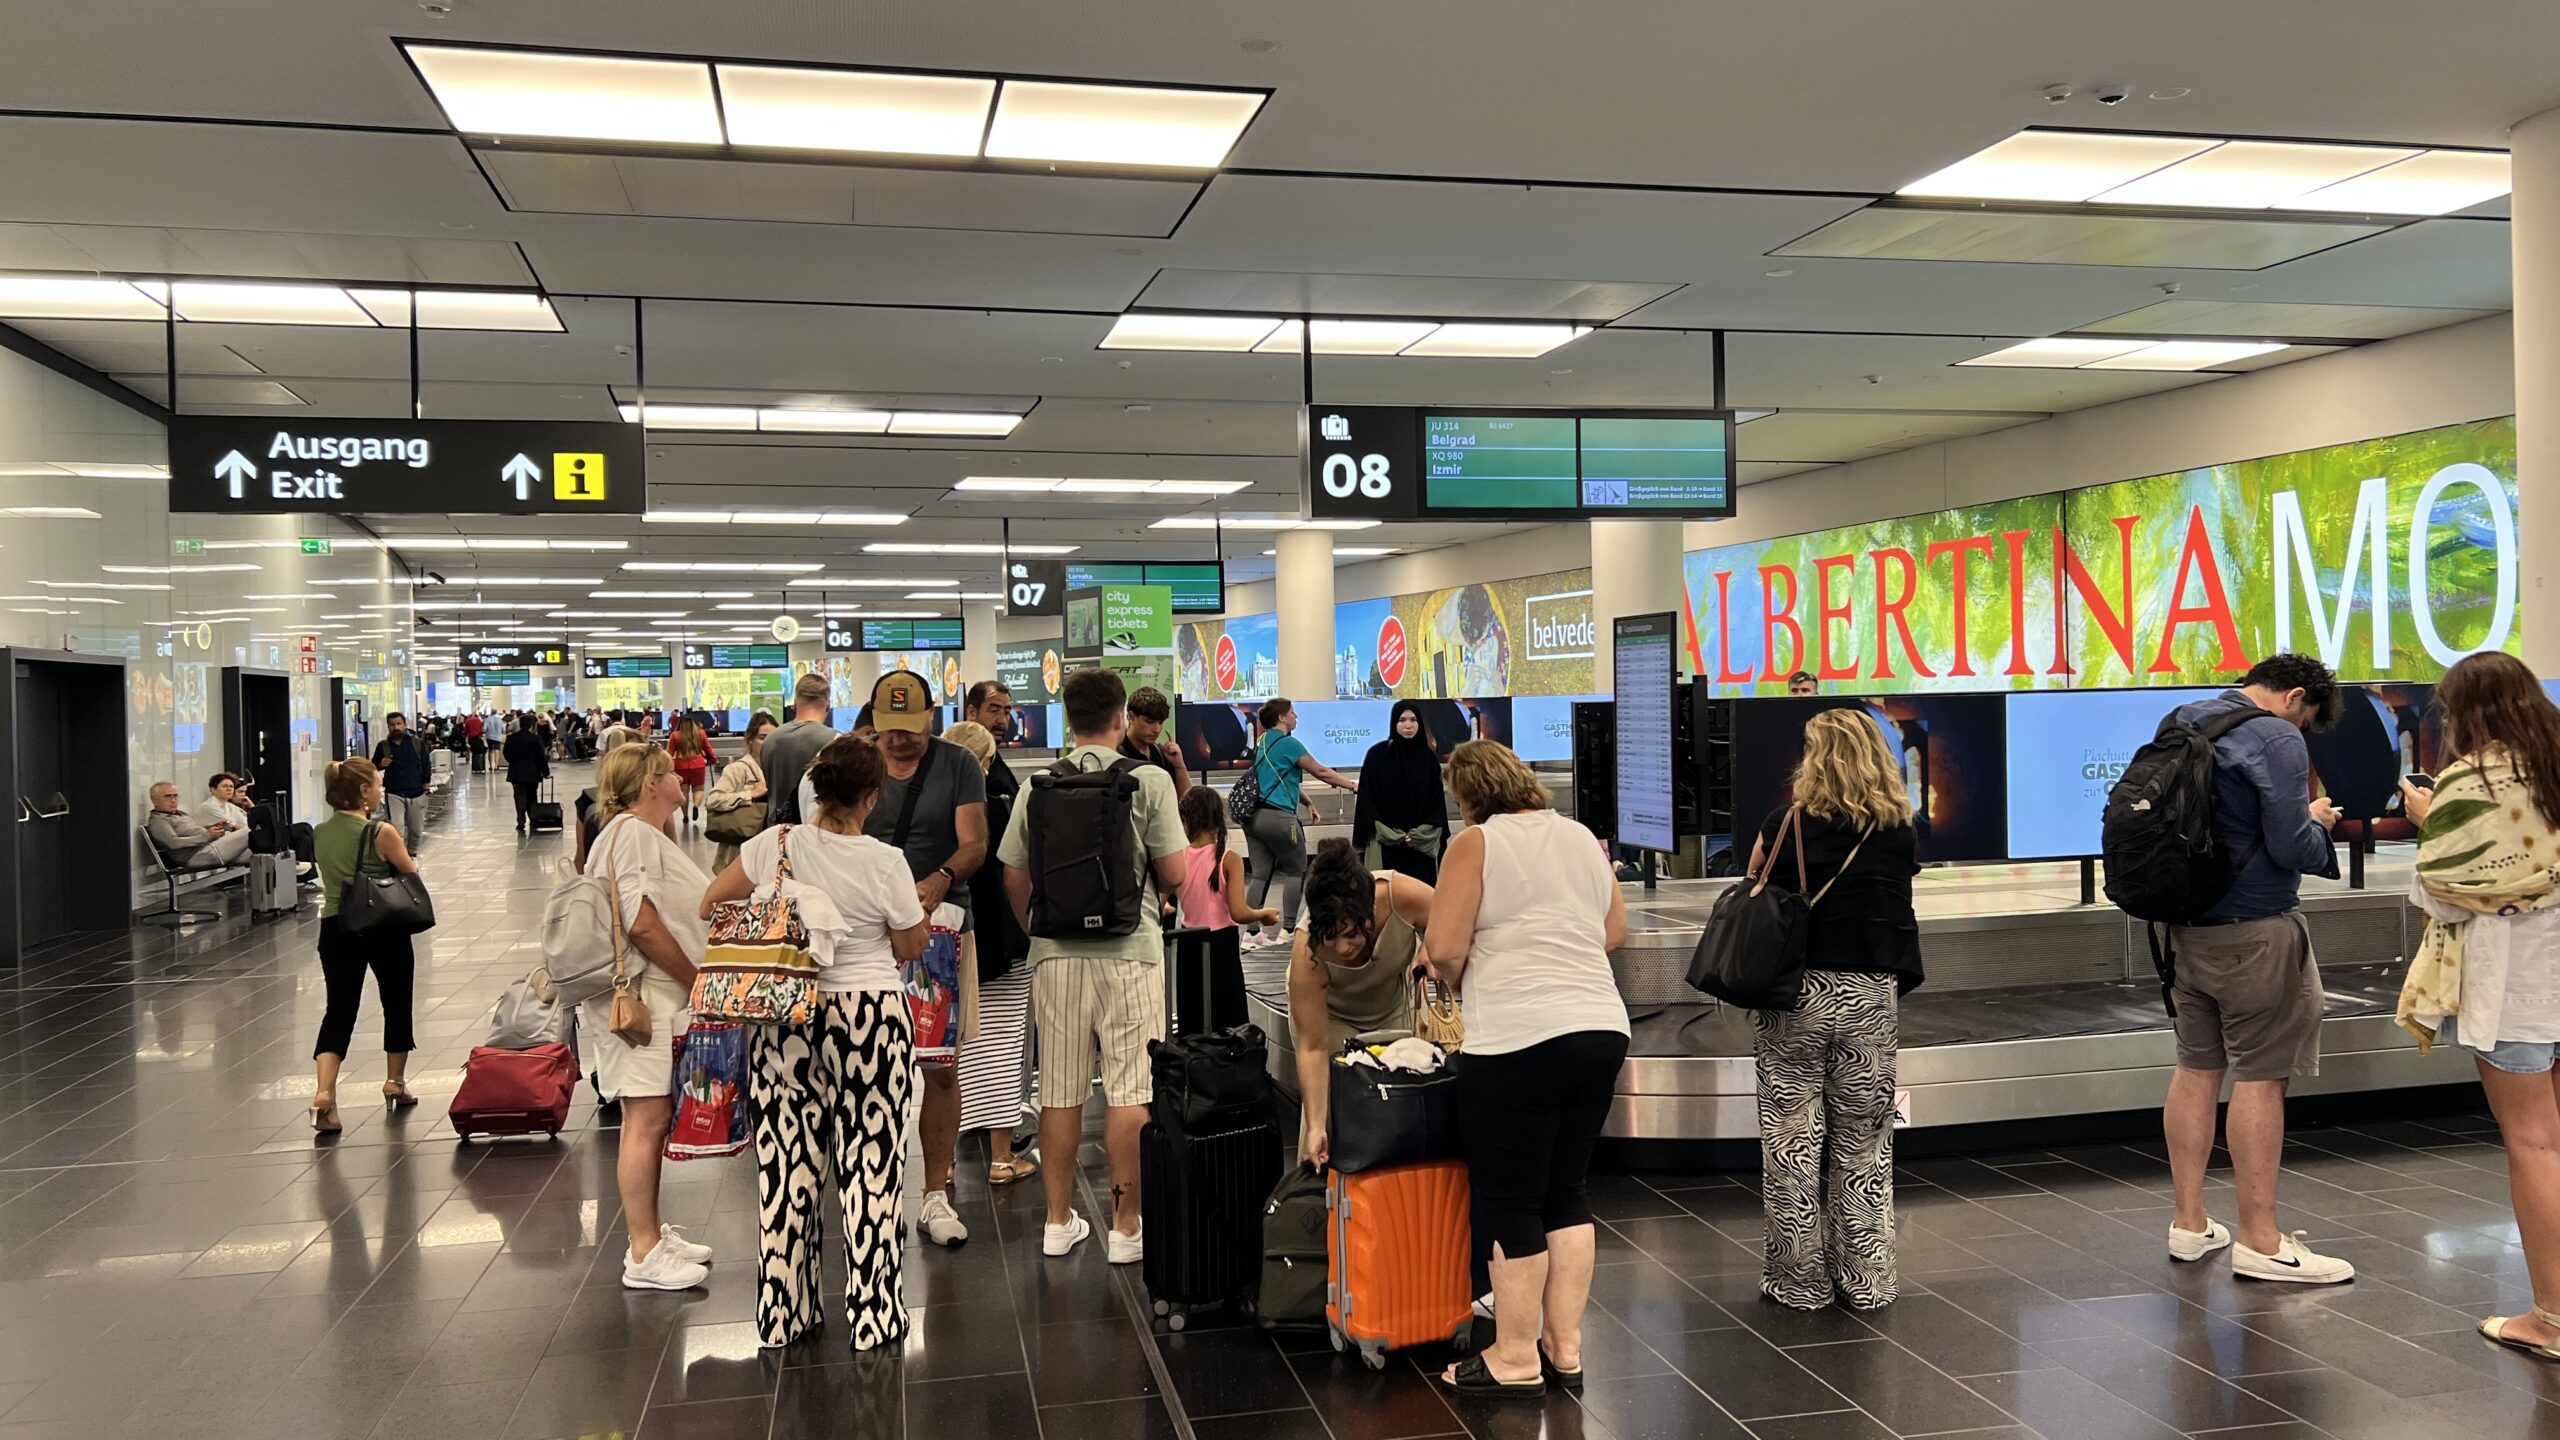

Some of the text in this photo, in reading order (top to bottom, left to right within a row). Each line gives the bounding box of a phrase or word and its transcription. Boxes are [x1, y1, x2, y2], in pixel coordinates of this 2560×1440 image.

[1431, 421, 1459, 431] JU 314
[1432, 434, 1476, 447] Belgrad
[268, 431, 429, 468] Ausgang
[1432, 451, 1463, 461] XQ 980
[1432, 464, 1462, 475] Izmir
[1322, 453, 1392, 498] 08
[272, 469, 345, 500] Exit
[1012, 583, 1046, 606] 07
[1106, 590, 1130, 604] city
[1107, 606, 1153, 617] express
[1107, 618, 1149, 629] tickets
[828, 632, 853, 647] 06
[481, 647, 519, 656] Ausgang
[481, 656, 499, 664] Exit
[686, 654, 705, 666] 05
[586, 665, 602, 676] 04
[457, 676, 470, 685] 03
[1324, 729, 1371, 737] GASTHAUS
